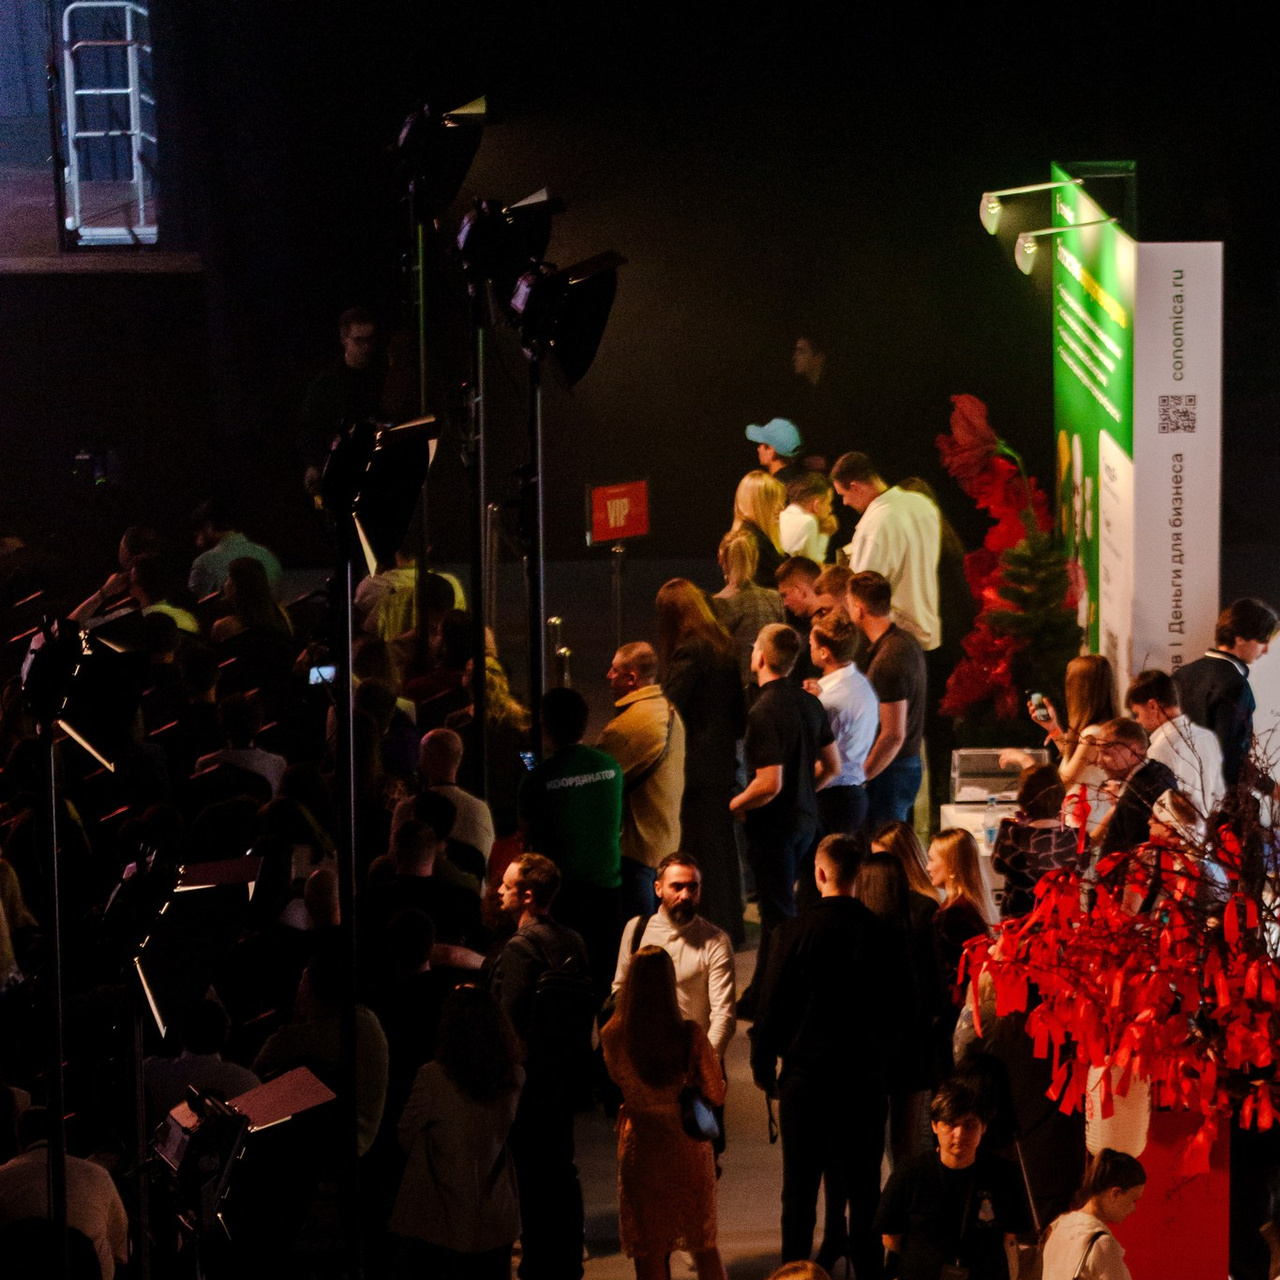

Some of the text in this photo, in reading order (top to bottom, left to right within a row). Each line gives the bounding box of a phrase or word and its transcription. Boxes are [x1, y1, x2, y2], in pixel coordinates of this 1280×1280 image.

[1169, 269, 1184, 381] conomica.ru
[607, 497, 630, 528] VIP
[1169, 453, 1184, 527] бизнеса
[1171, 532, 1184, 564] для
[1168, 570, 1185, 634] Деньги
